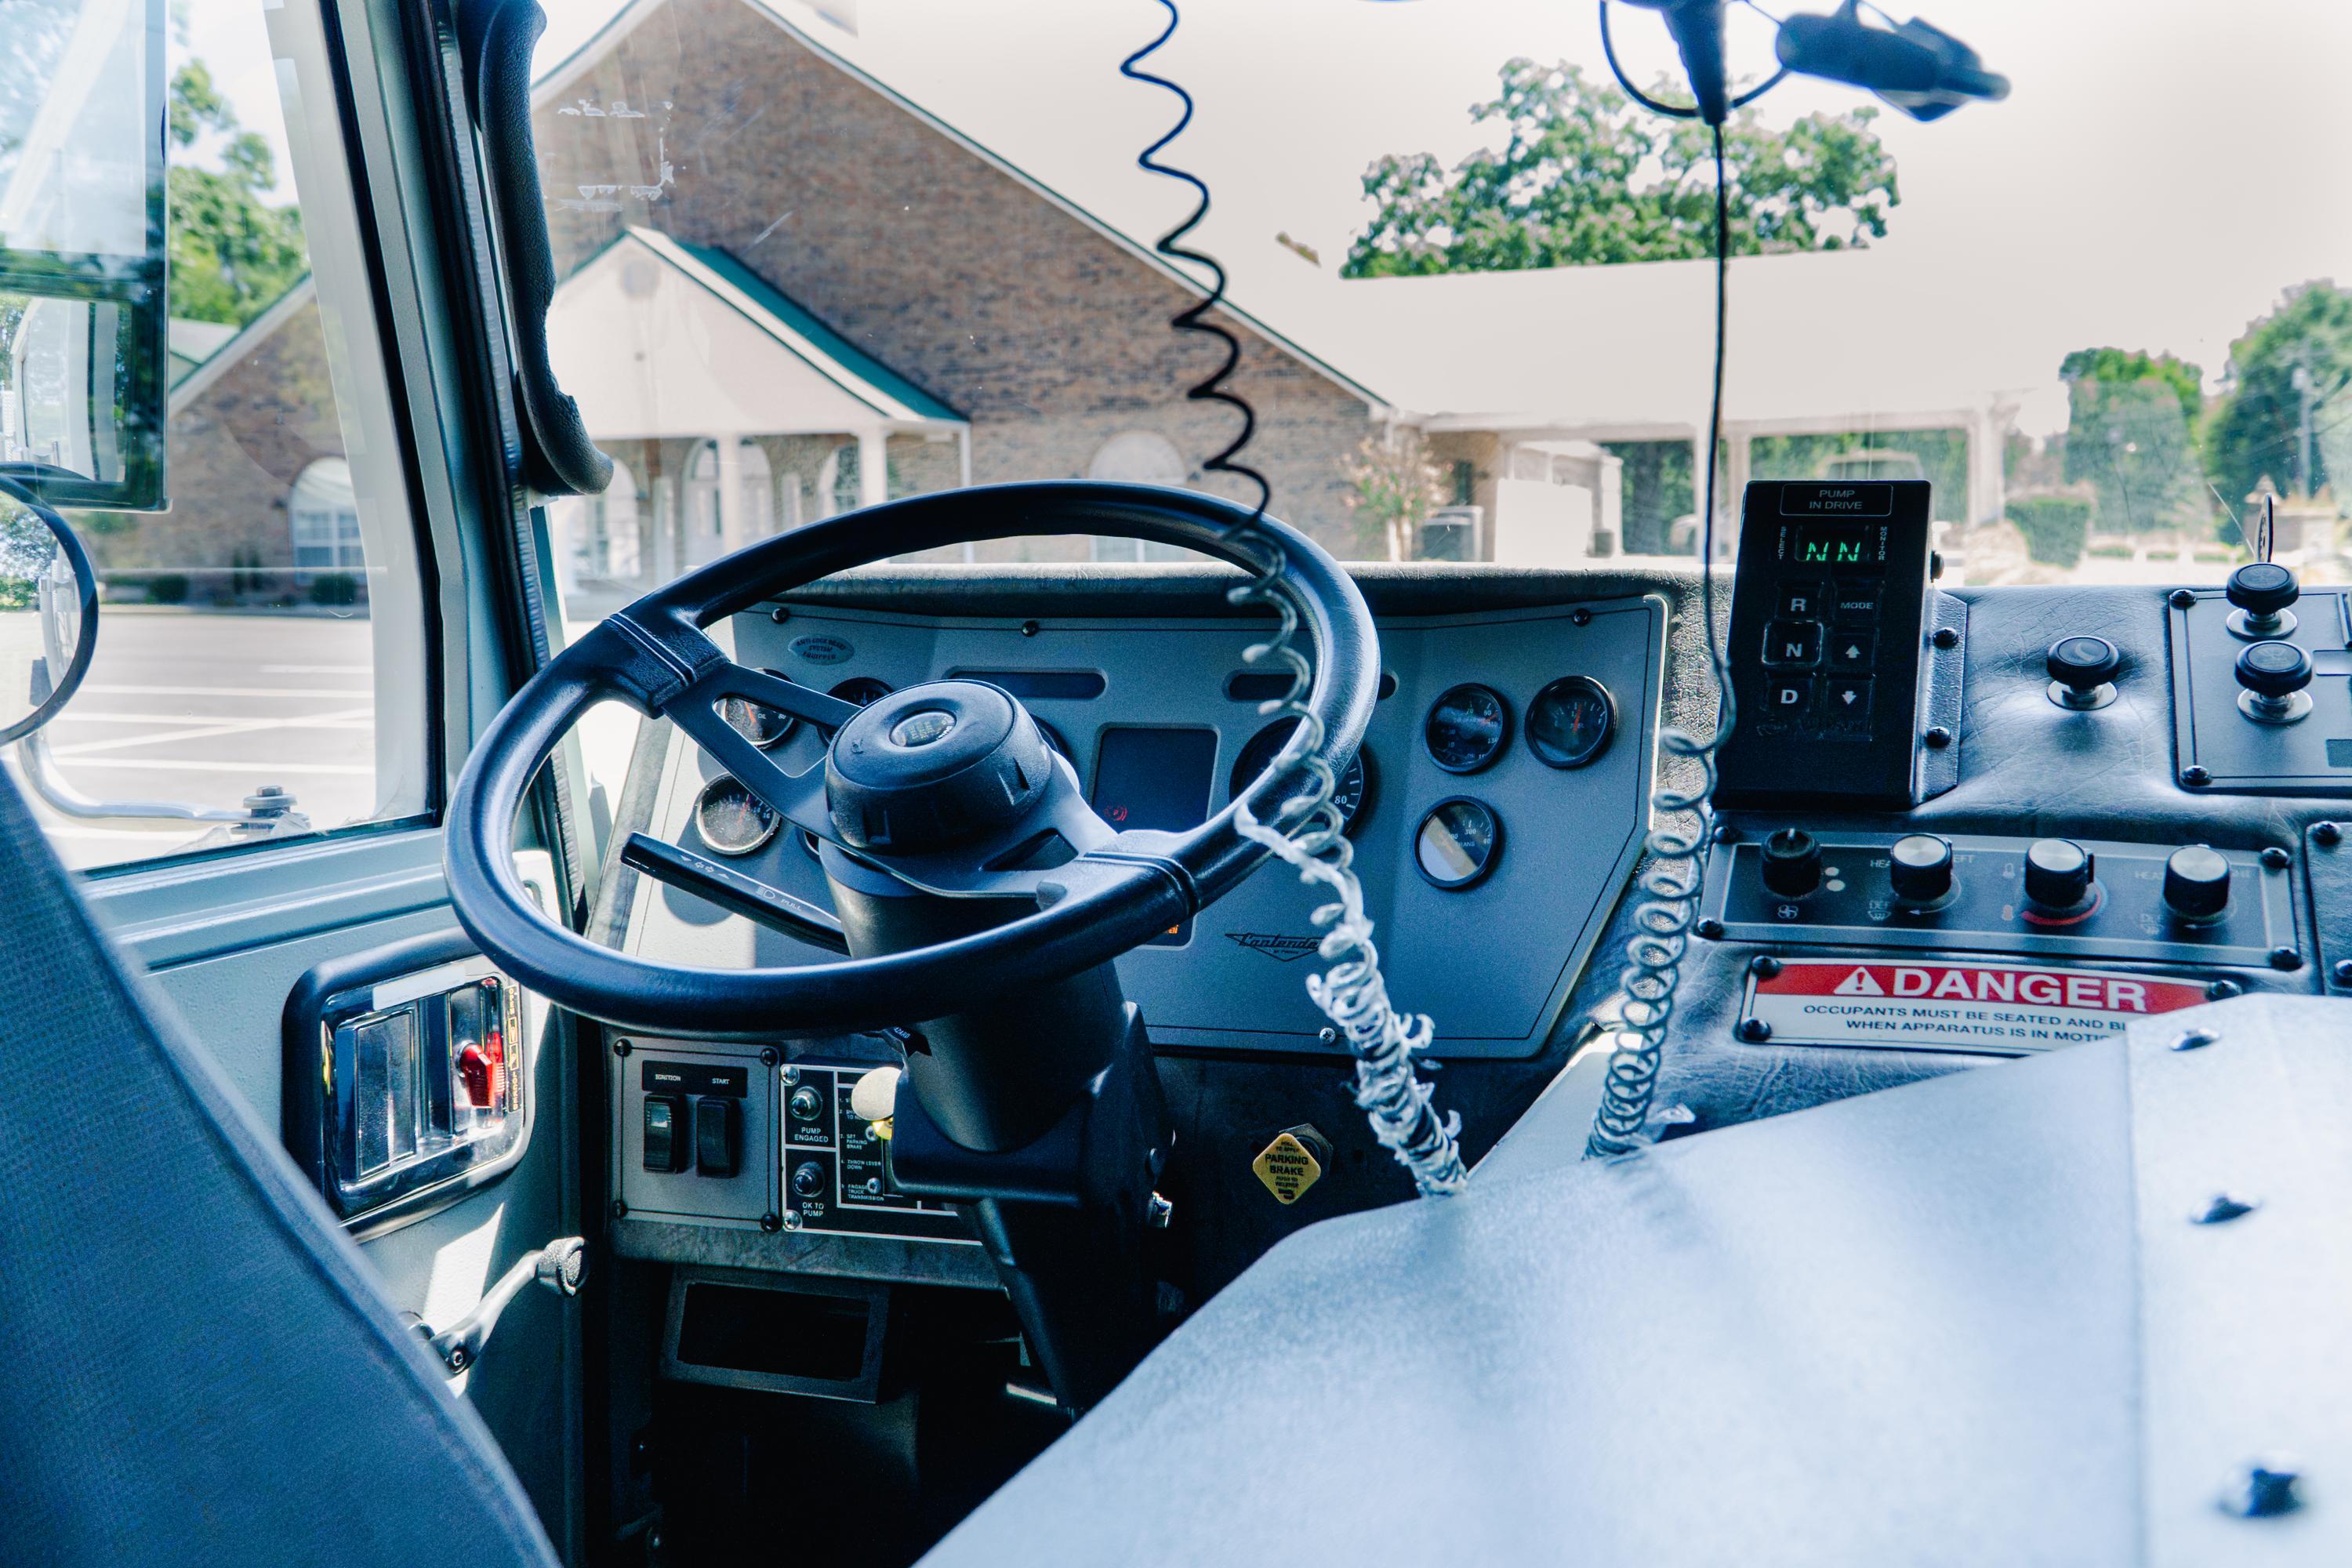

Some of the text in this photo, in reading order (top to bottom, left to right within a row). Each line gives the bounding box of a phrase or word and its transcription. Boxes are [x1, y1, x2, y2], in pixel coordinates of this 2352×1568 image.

[1819, 489, 1856, 498] PUMP
[1809, 501, 1864, 510] IN DRIVE
[1878, 526, 1888, 561] MONITOR
[1806, 542, 1860, 561] N N
[1791, 597, 1807, 612] R
[1786, 643, 1803, 658] N
[1780, 689, 1798, 704] D
[1334, 795, 1348, 804] 80
[780, 898, 803, 912] PULL
[1239, 932, 1320, 949] Contende
[1892, 967, 2147, 1012] DANGER
[1803, 1005, 1907, 1018] OCCUPANTS
[1912, 1009, 1961, 1020] MUST
[1965, 1011, 1989, 1022] BE
[1993, 1012, 2062, 1025] SEATED
[2067, 1018, 2105, 1029] AND
[1846, 1020, 1896, 1031] WHEN
[1900, 1022, 2006, 1036] APPARATUS
[2009, 1028, 2027, 1037] IS
[2031, 1030, 2049, 1040] IN
[794, 1134, 829, 1143] ENGAGED
[1265, 1153, 1308, 1165] PARKING
[1269, 1165, 1305, 1177] BRAKE
